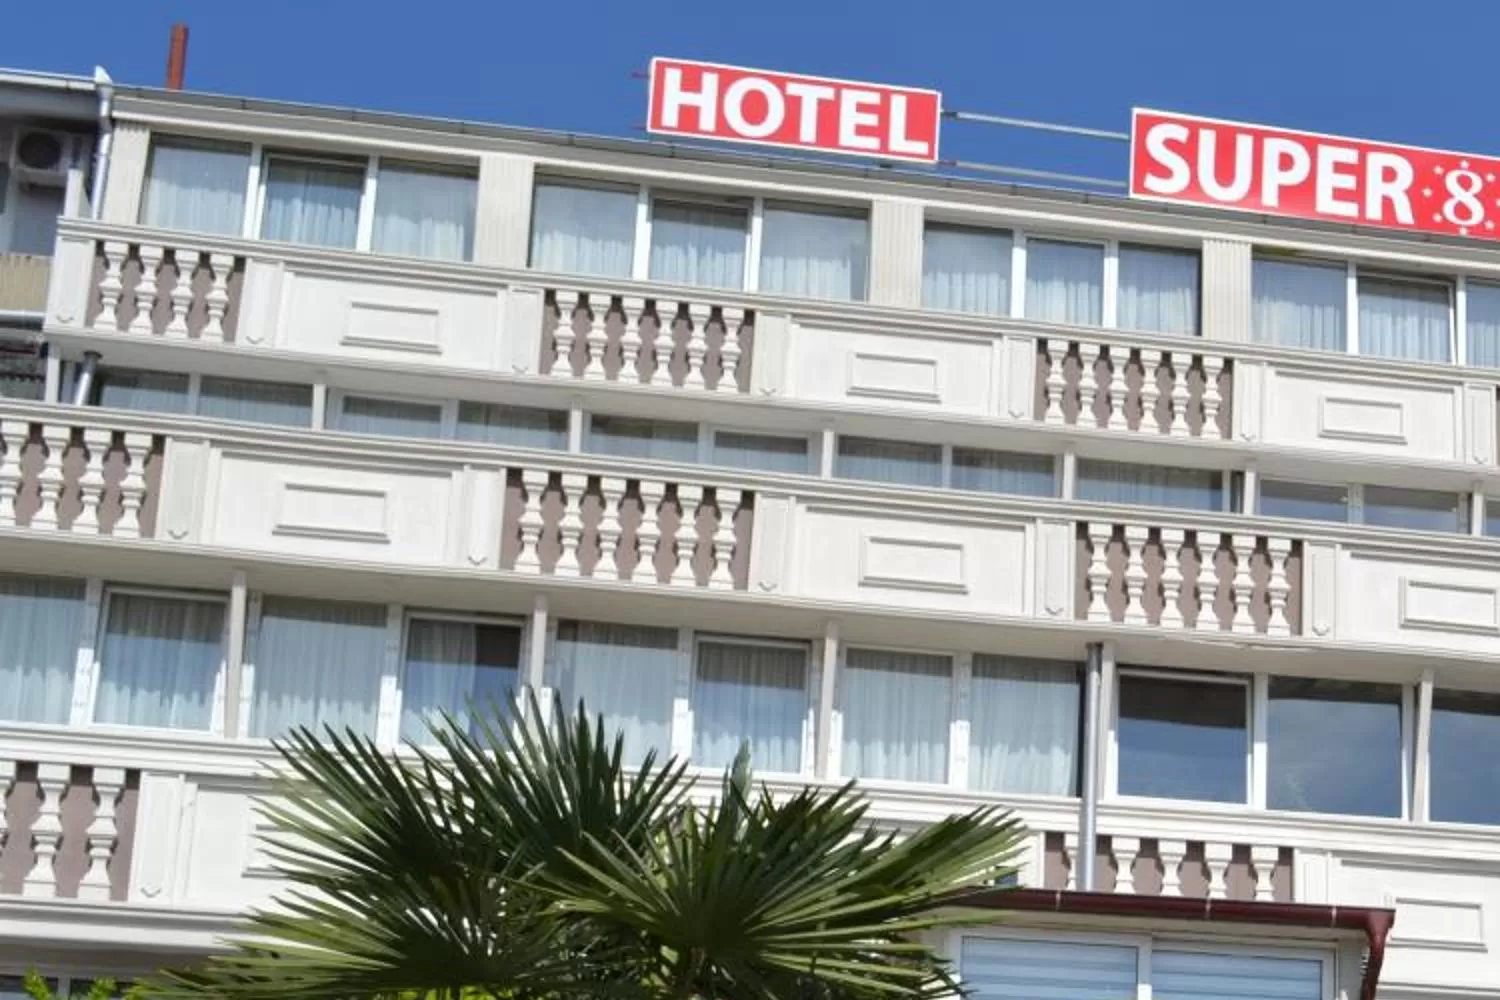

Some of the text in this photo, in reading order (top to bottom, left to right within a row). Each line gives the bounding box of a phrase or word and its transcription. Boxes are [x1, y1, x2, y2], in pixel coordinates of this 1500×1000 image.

[661, 67, 929, 155] HOTEL
[1143, 122, 1485, 226] SUPER 8
